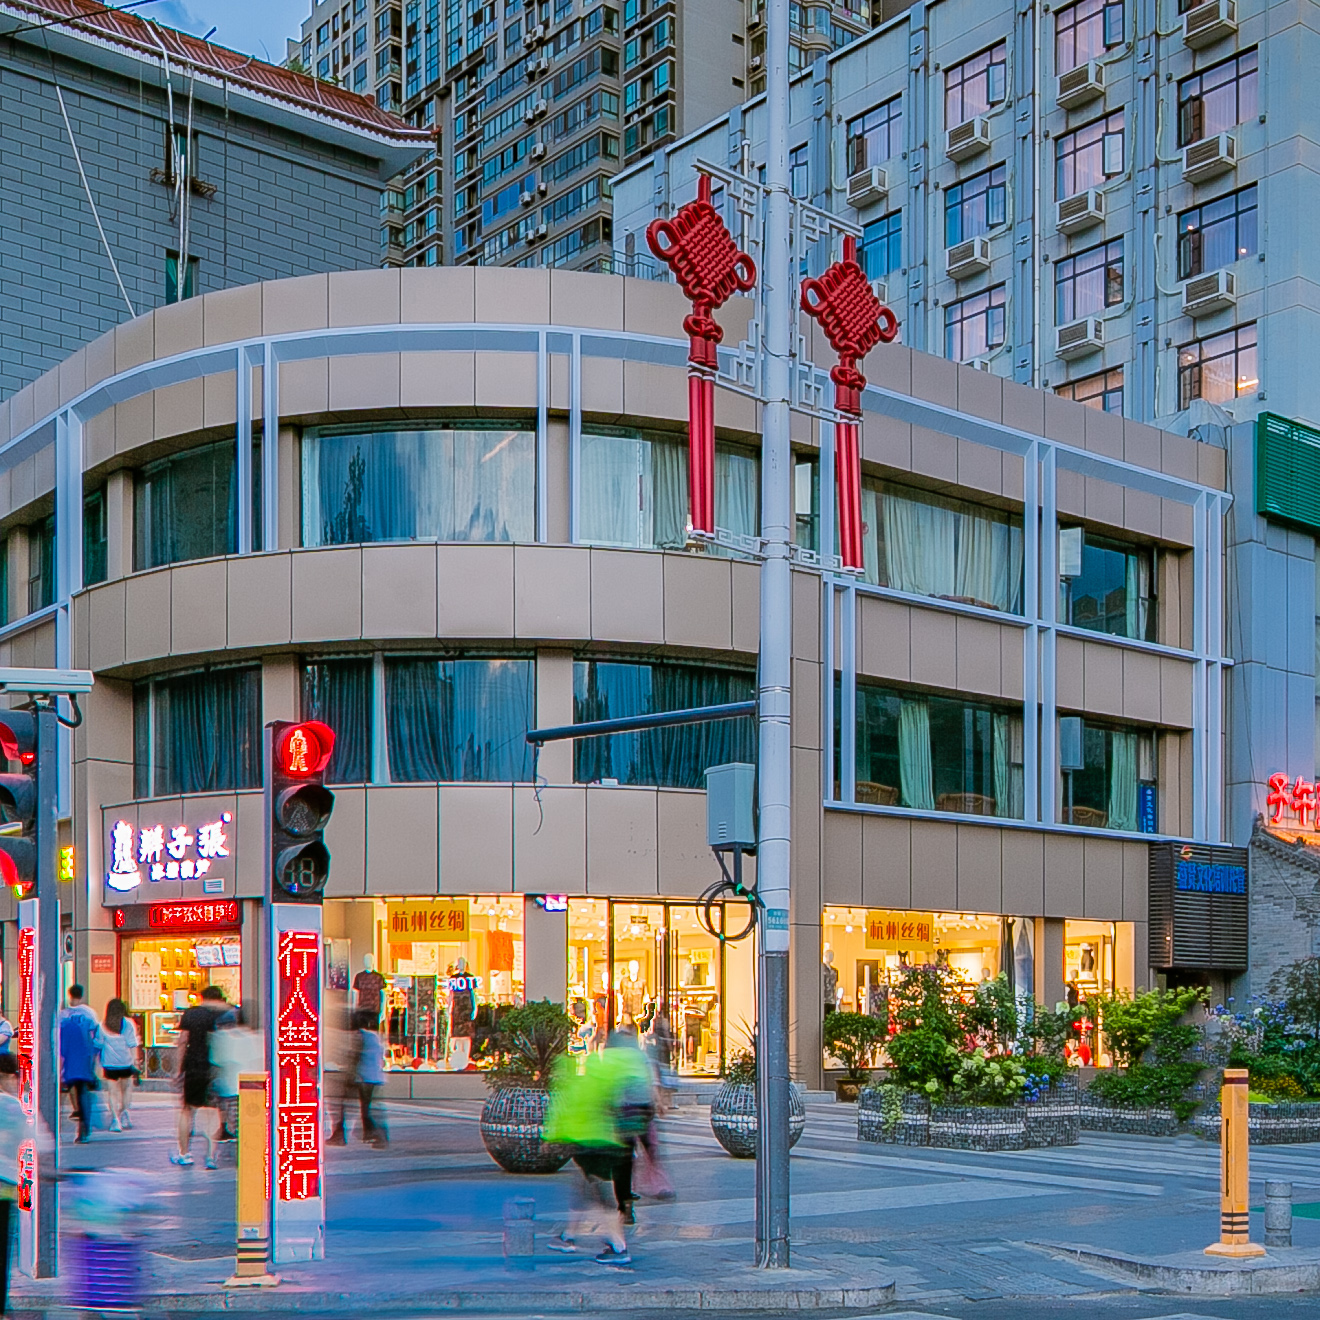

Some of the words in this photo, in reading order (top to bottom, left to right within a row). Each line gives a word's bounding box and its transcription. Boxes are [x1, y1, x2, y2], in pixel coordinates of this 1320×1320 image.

[392, 910, 465, 932] 杭州丝绸
[870, 920, 930, 942] 杭州丝绸
[278, 931, 318, 1200] 行人禁止通行
